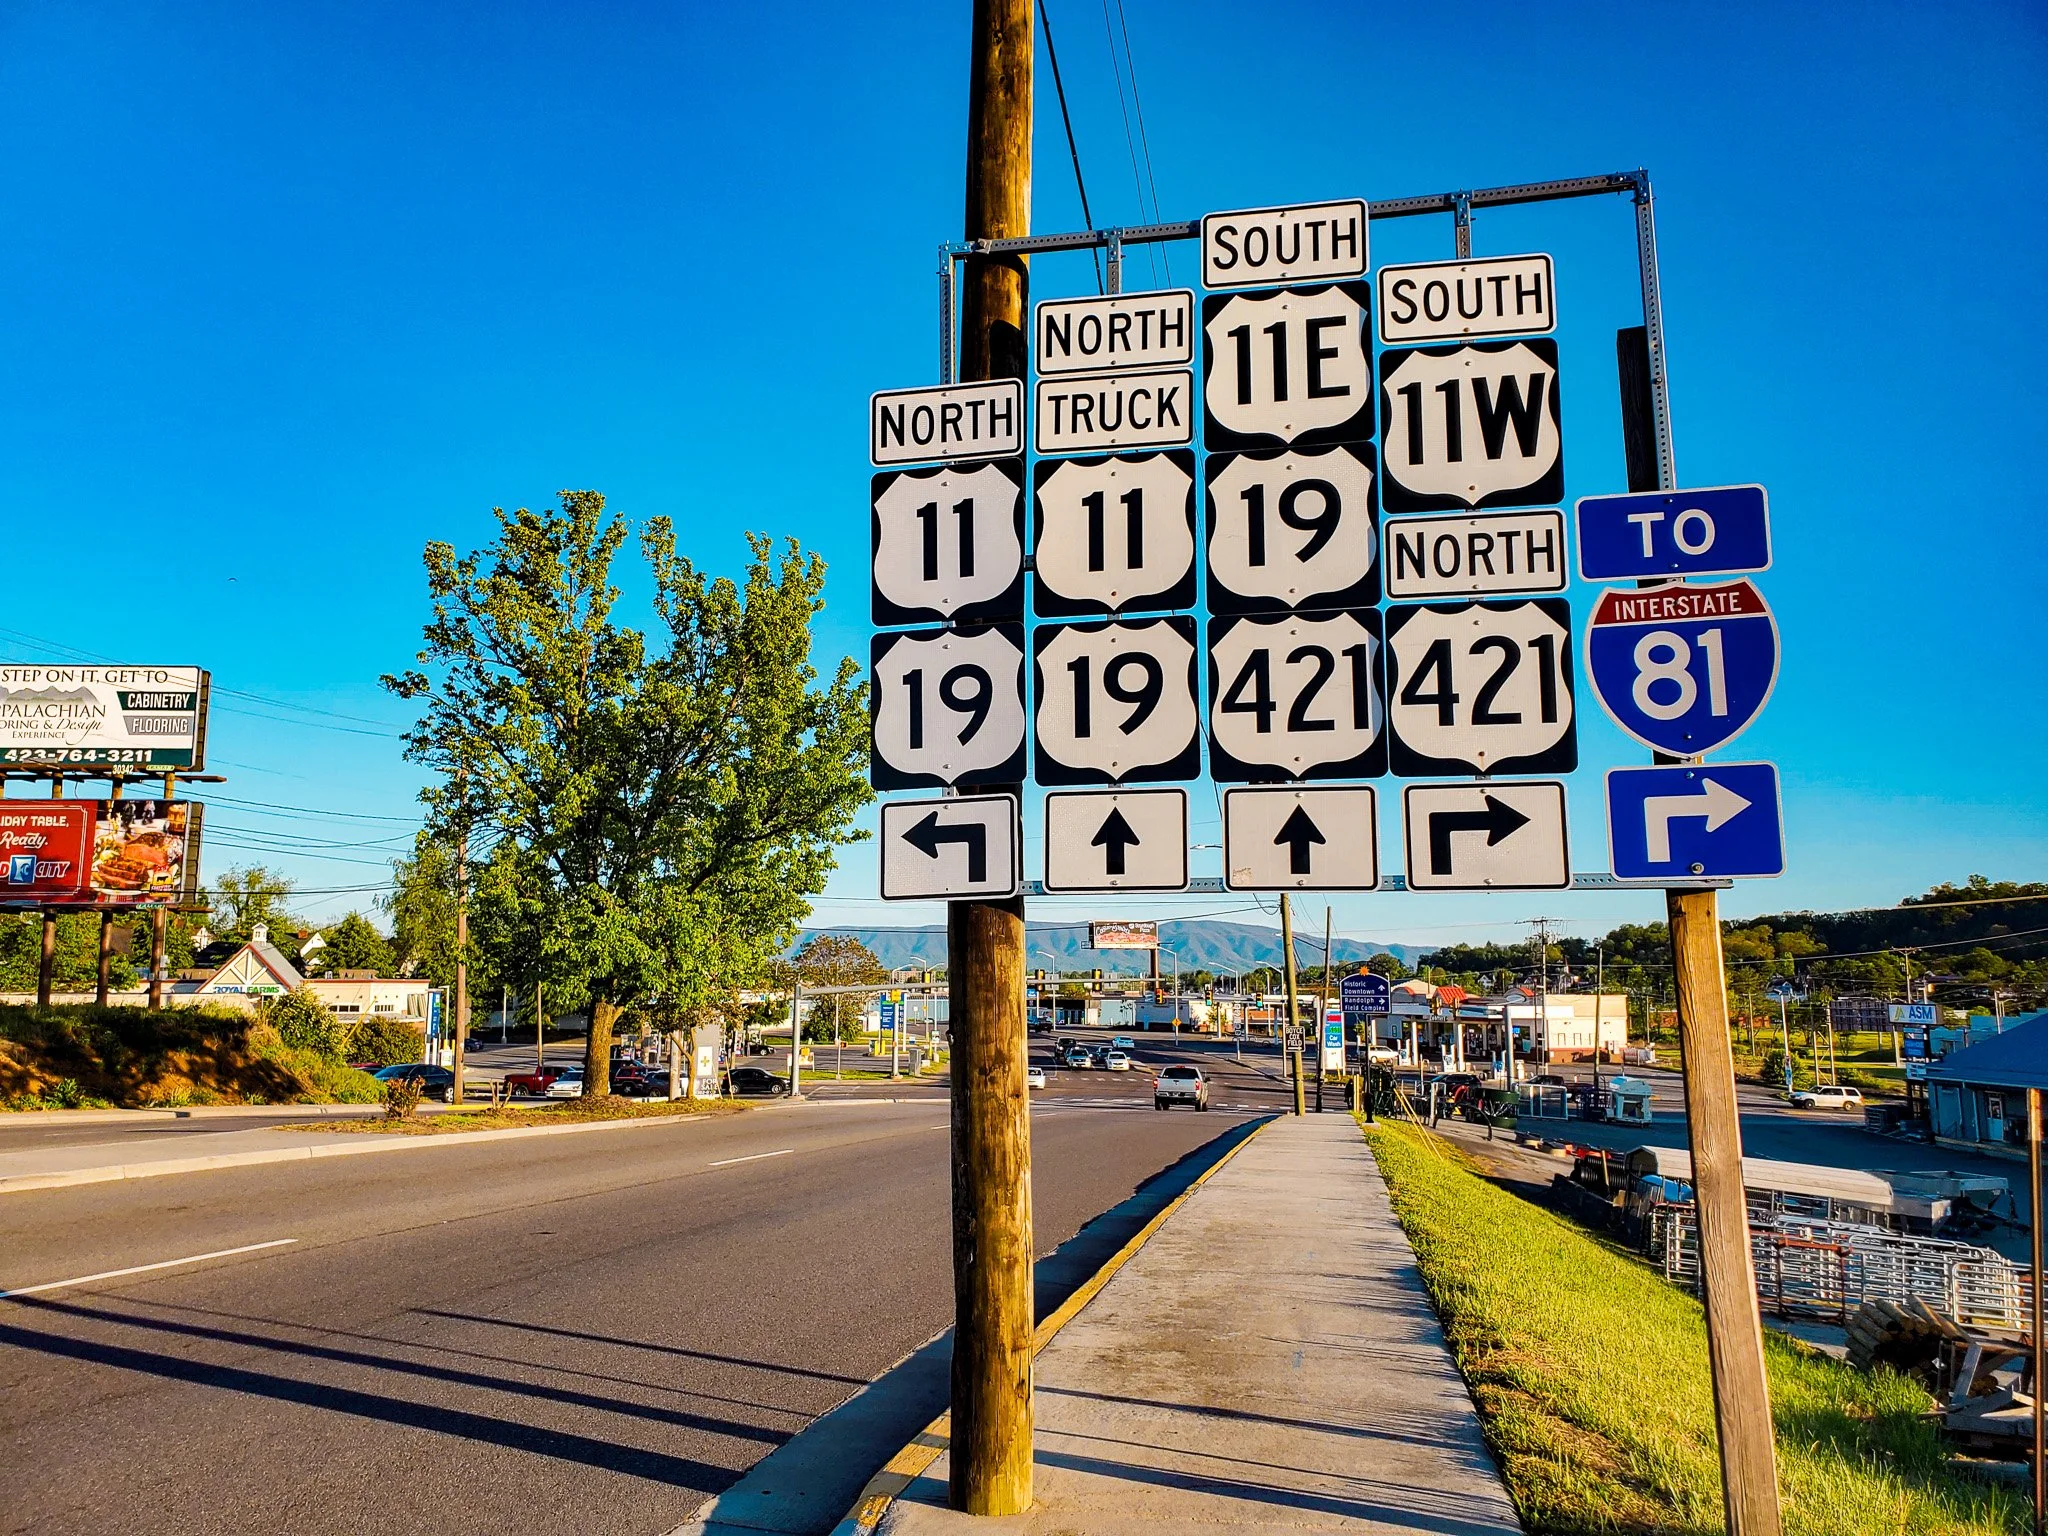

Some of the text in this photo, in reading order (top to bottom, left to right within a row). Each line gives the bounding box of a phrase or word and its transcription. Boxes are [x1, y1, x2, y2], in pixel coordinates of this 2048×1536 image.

[1212, 217, 1358, 269] SOUTH
[1390, 273, 1543, 325] SOUTH
[1045, 305, 1185, 358] NORTH
[1227, 315, 1351, 407] 11E
[880, 396, 1013, 447] NORTH
[1048, 387, 1182, 435] TRUCK
[1397, 371, 1546, 467] 11W
[915, 496, 976, 583] 11
[1081, 487, 1144, 574] 11
[1240, 477, 1343, 568] 19
[1627, 508, 1716, 558] TO
[1397, 527, 1555, 579] NORTH
[1614, 591, 1742, 621] INTERSTATE
[1, 668, 168, 684] STEP ON IT, GET TO
[1066, 650, 1165, 739] 19
[1222, 642, 1371, 735] 421
[1399, 633, 1559, 727] 421
[1632, 628, 1728, 721] 81
[0, 703, 106, 718] PALACHIAN
[127, 692, 190, 709] CABINETRY
[132, 718, 188, 733] FLOORING
[901, 665, 994, 752] 19
[4, 749, 153, 762] 423-764-3211
[56, 717, 104, 746] Design
[112, 764, 134, 775] 30342
[0, 816, 70, 828] IDAY TABLE,
[0, 831, 49, 849] Ready.
[35, 861, 71, 878] CITY
[213, 986, 280, 994] ROYAL FARMS
[1344, 997, 1375, 1005] Randolph
[1908, 1006, 1933, 1019] ASM
